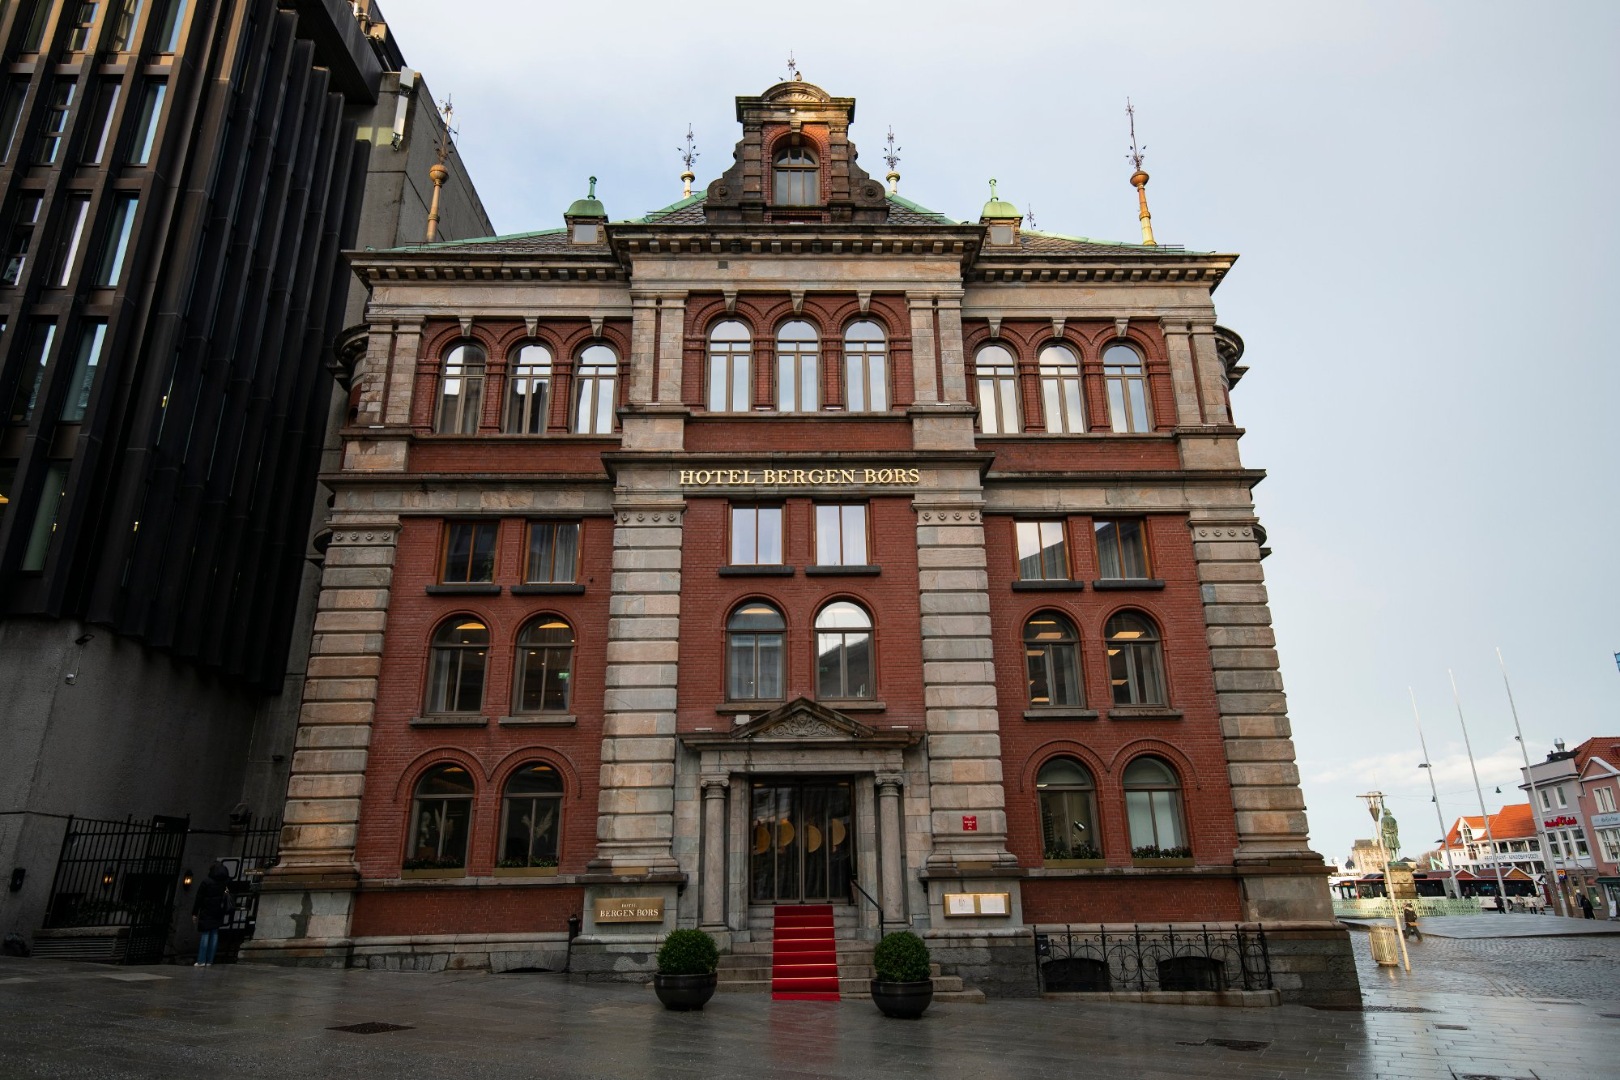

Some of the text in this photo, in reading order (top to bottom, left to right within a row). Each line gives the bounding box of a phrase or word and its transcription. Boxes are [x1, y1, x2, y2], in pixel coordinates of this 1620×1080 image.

[679, 468, 921, 484] HOTEL BERGEN BØRS
[600, 909, 635, 917] BERGEN
